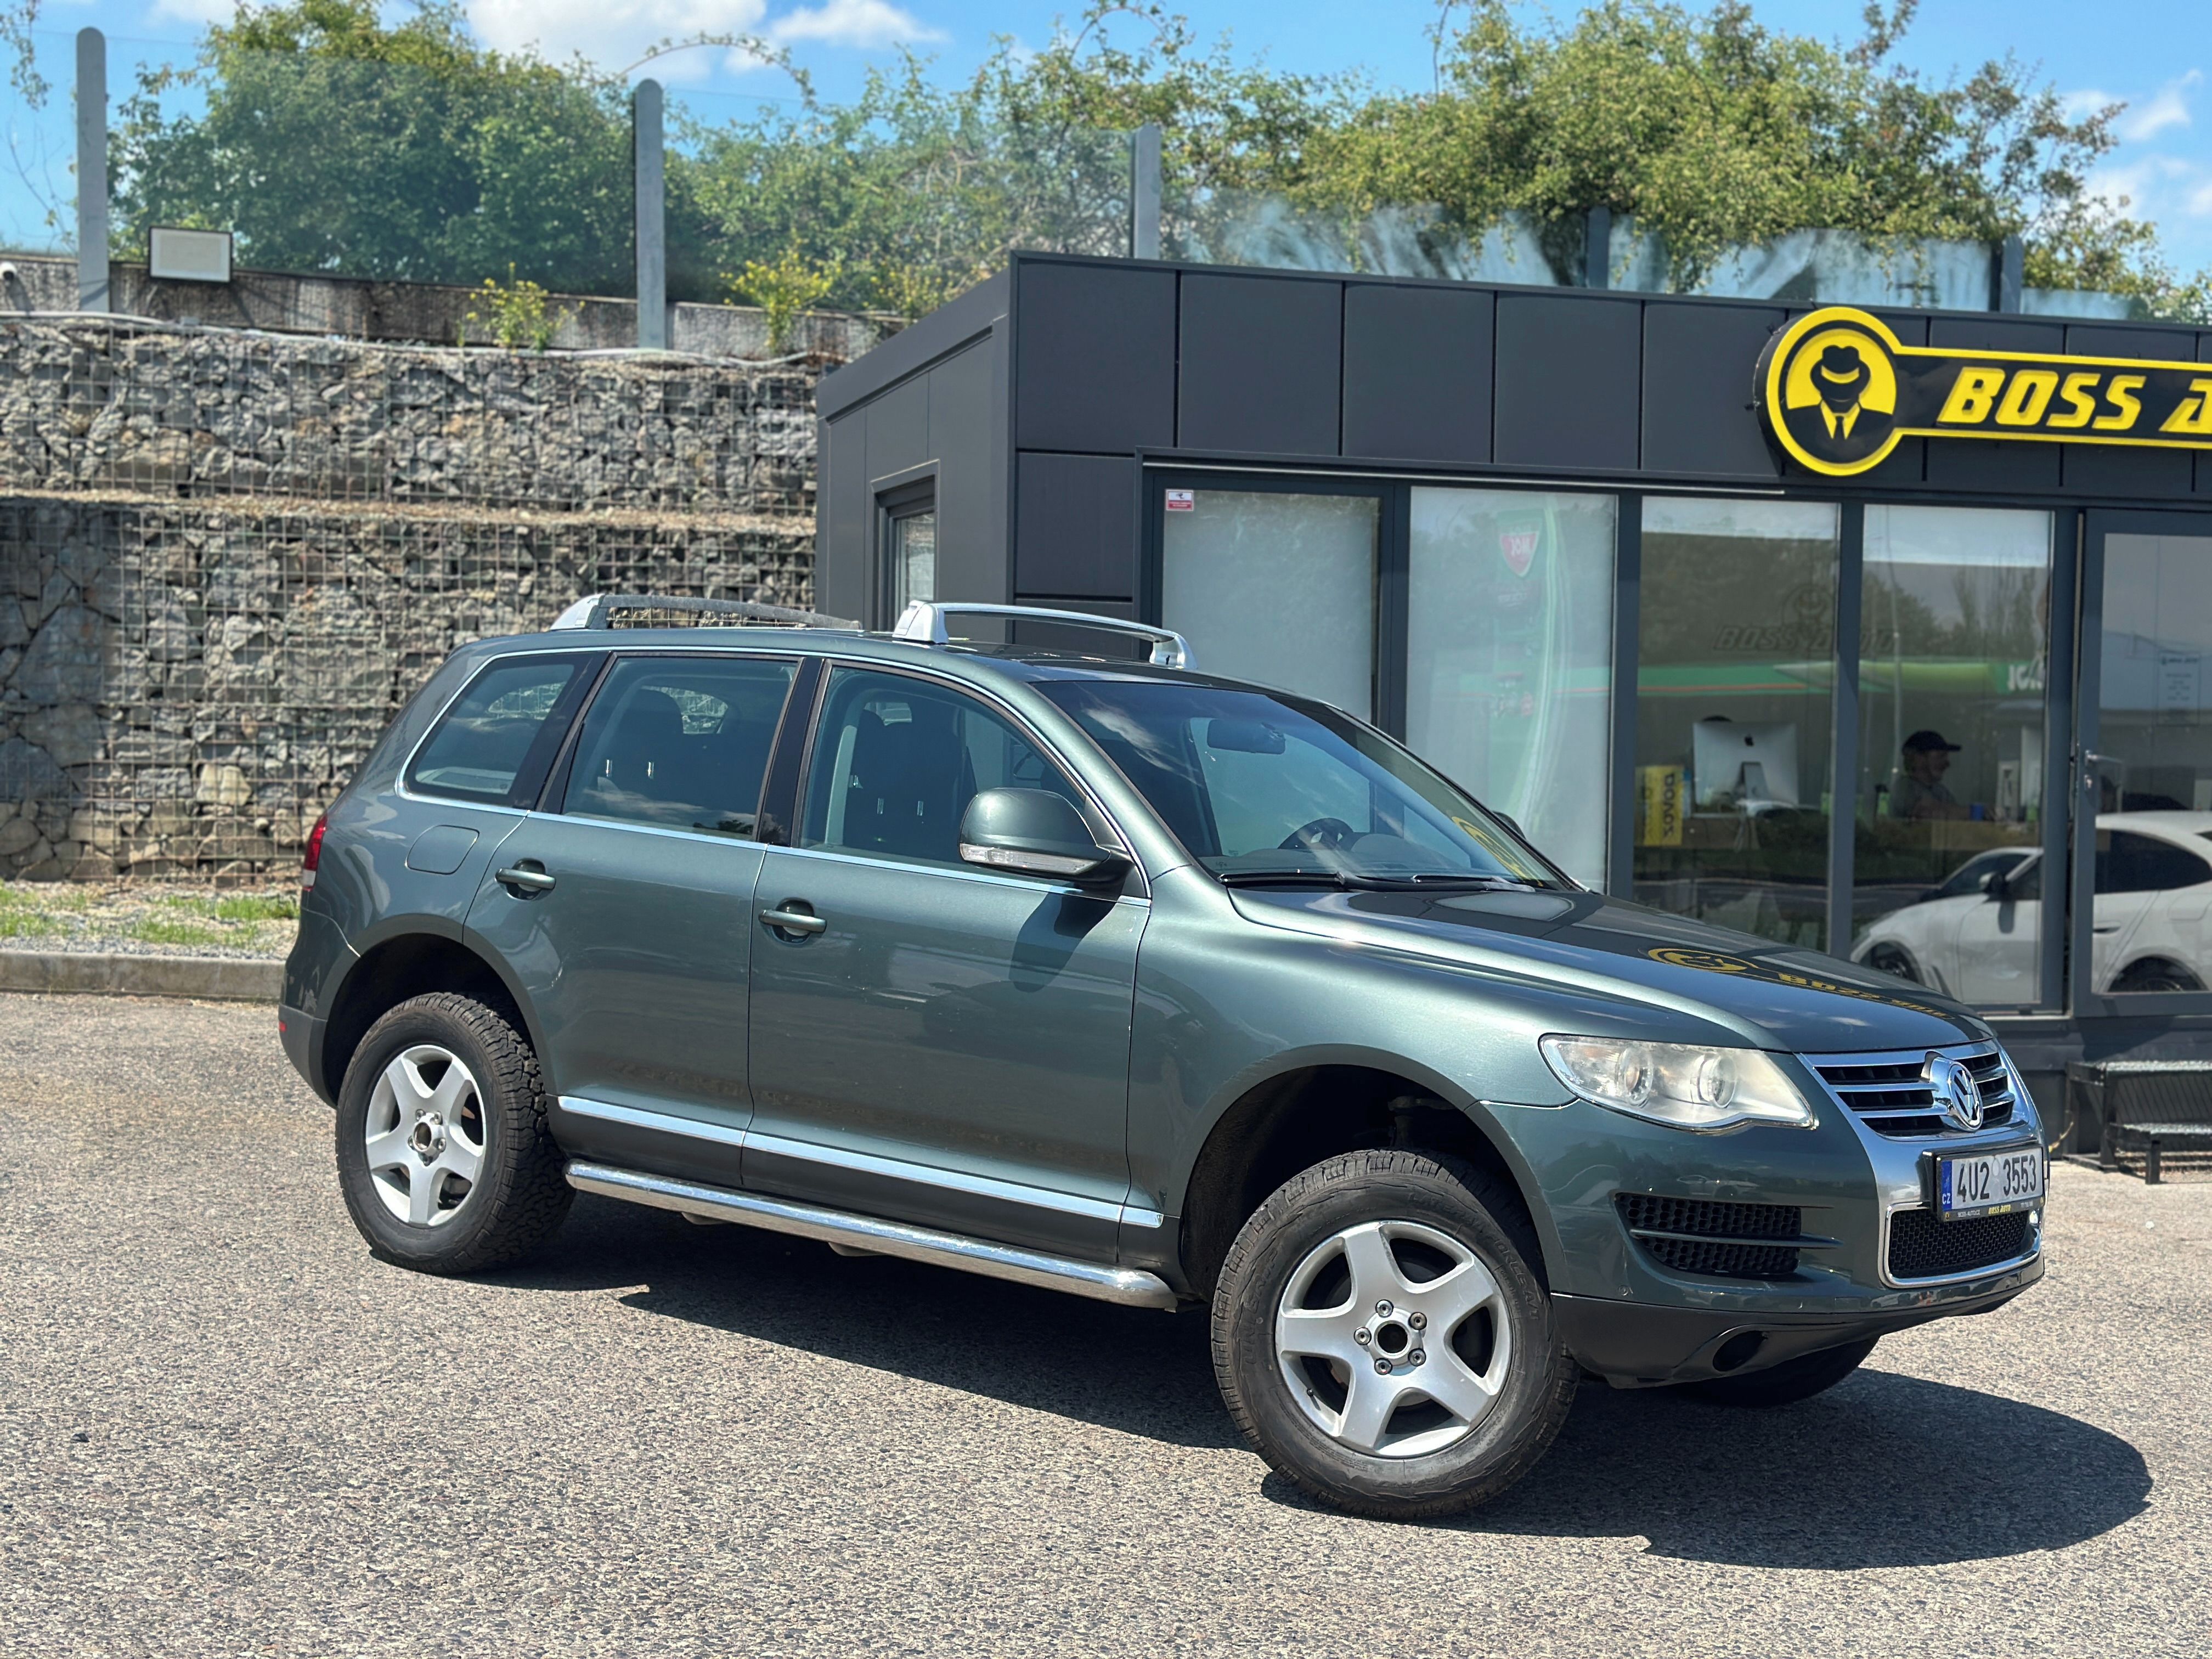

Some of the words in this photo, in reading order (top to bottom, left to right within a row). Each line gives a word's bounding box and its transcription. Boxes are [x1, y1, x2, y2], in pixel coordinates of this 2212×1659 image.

[1937, 366, 2147, 431] BOSS
[1942, 1193, 1951, 1205] CZ
[1957, 1161, 1990, 1203] 4U2
[2003, 1154, 2036, 1197] 3553
